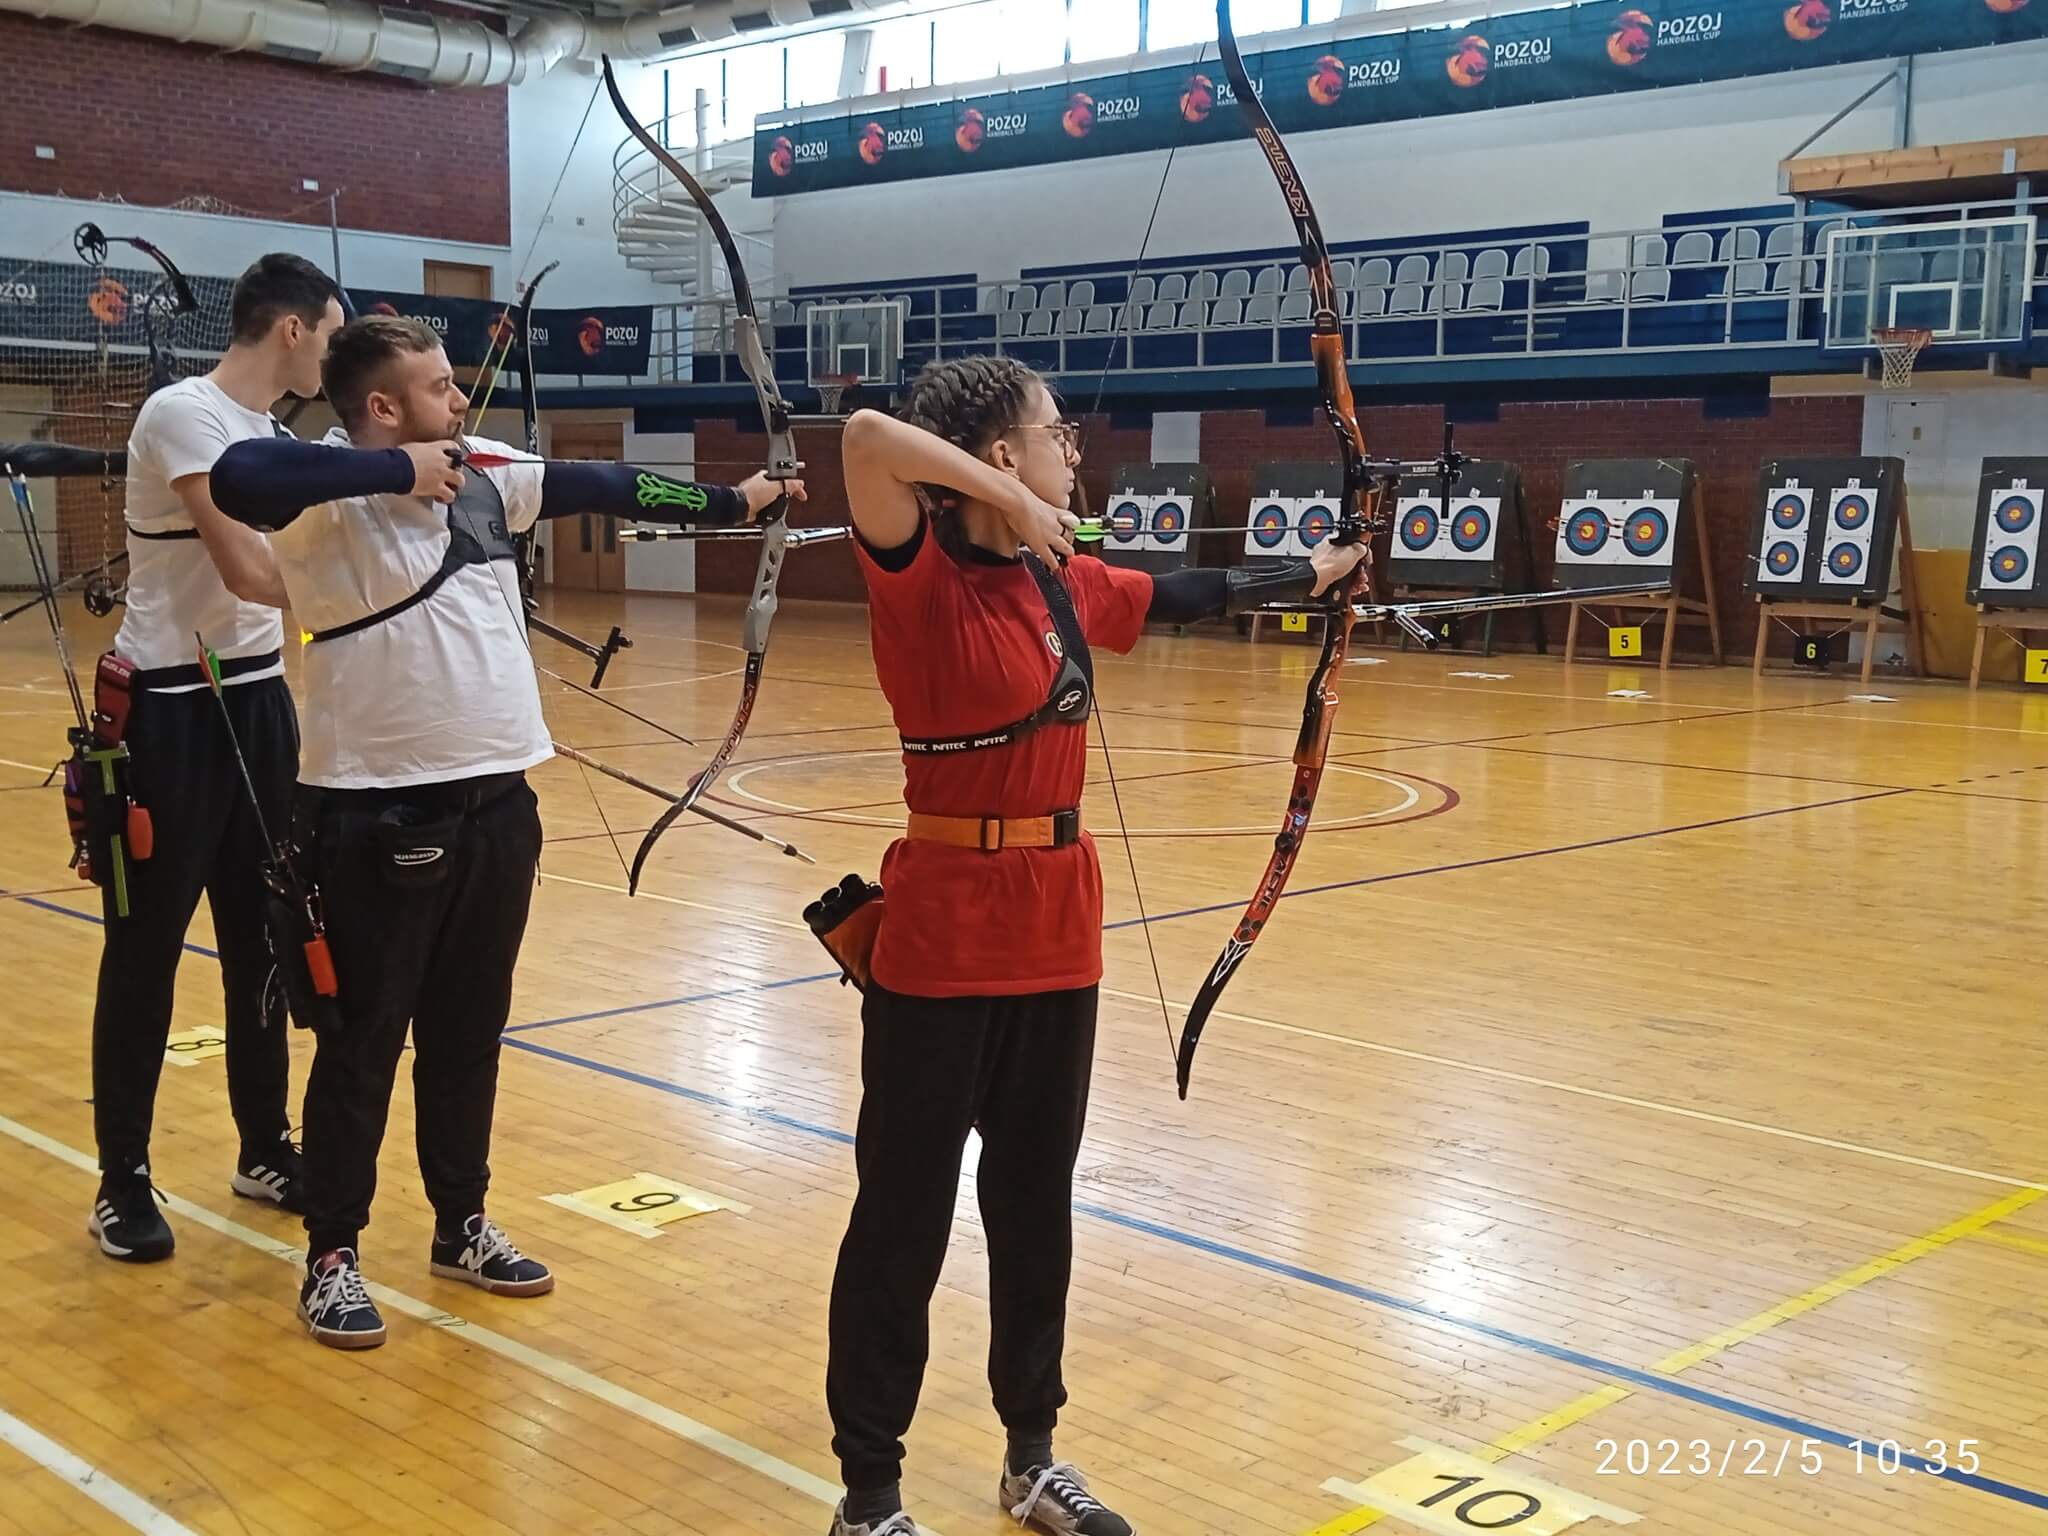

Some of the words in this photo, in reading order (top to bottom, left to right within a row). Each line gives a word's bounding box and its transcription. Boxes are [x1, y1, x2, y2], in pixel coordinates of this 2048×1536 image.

[1840, 6, 1886, 20] HANDBALL
[1889, 2, 1908, 12] CUP
[1657, 12, 1722, 38] POZOJ
[1657, 33, 1701, 46] HANDBALL
[1703, 30, 1721, 41] CUP
[1494, 37, 1551, 61] POZOJ
[1349, 58, 1400, 81] POZOJ
[1494, 58, 1532, 69] HANDBALL
[1535, 54, 1551, 65] CUP
[1217, 78, 1263, 99] POOJ
[1348, 77, 1384, 88] HANDBALL
[1385, 75, 1400, 85] CUP
[1097, 96, 1140, 116] POZOJ
[987, 113, 1027, 132] POZOJ
[888, 127, 923, 145] POZOJ
[794, 140, 828, 158] POZOJ
[606, 326, 638, 340] POZOJ
[1441, 623, 1450, 637] 4
[1620, 635, 1629, 649] 5
[1806, 643, 1817, 658] 6
[167, 1038, 227, 1051] 8
[610, 1193, 680, 1212] 9
[1416, 1475, 1542, 1528] 10
